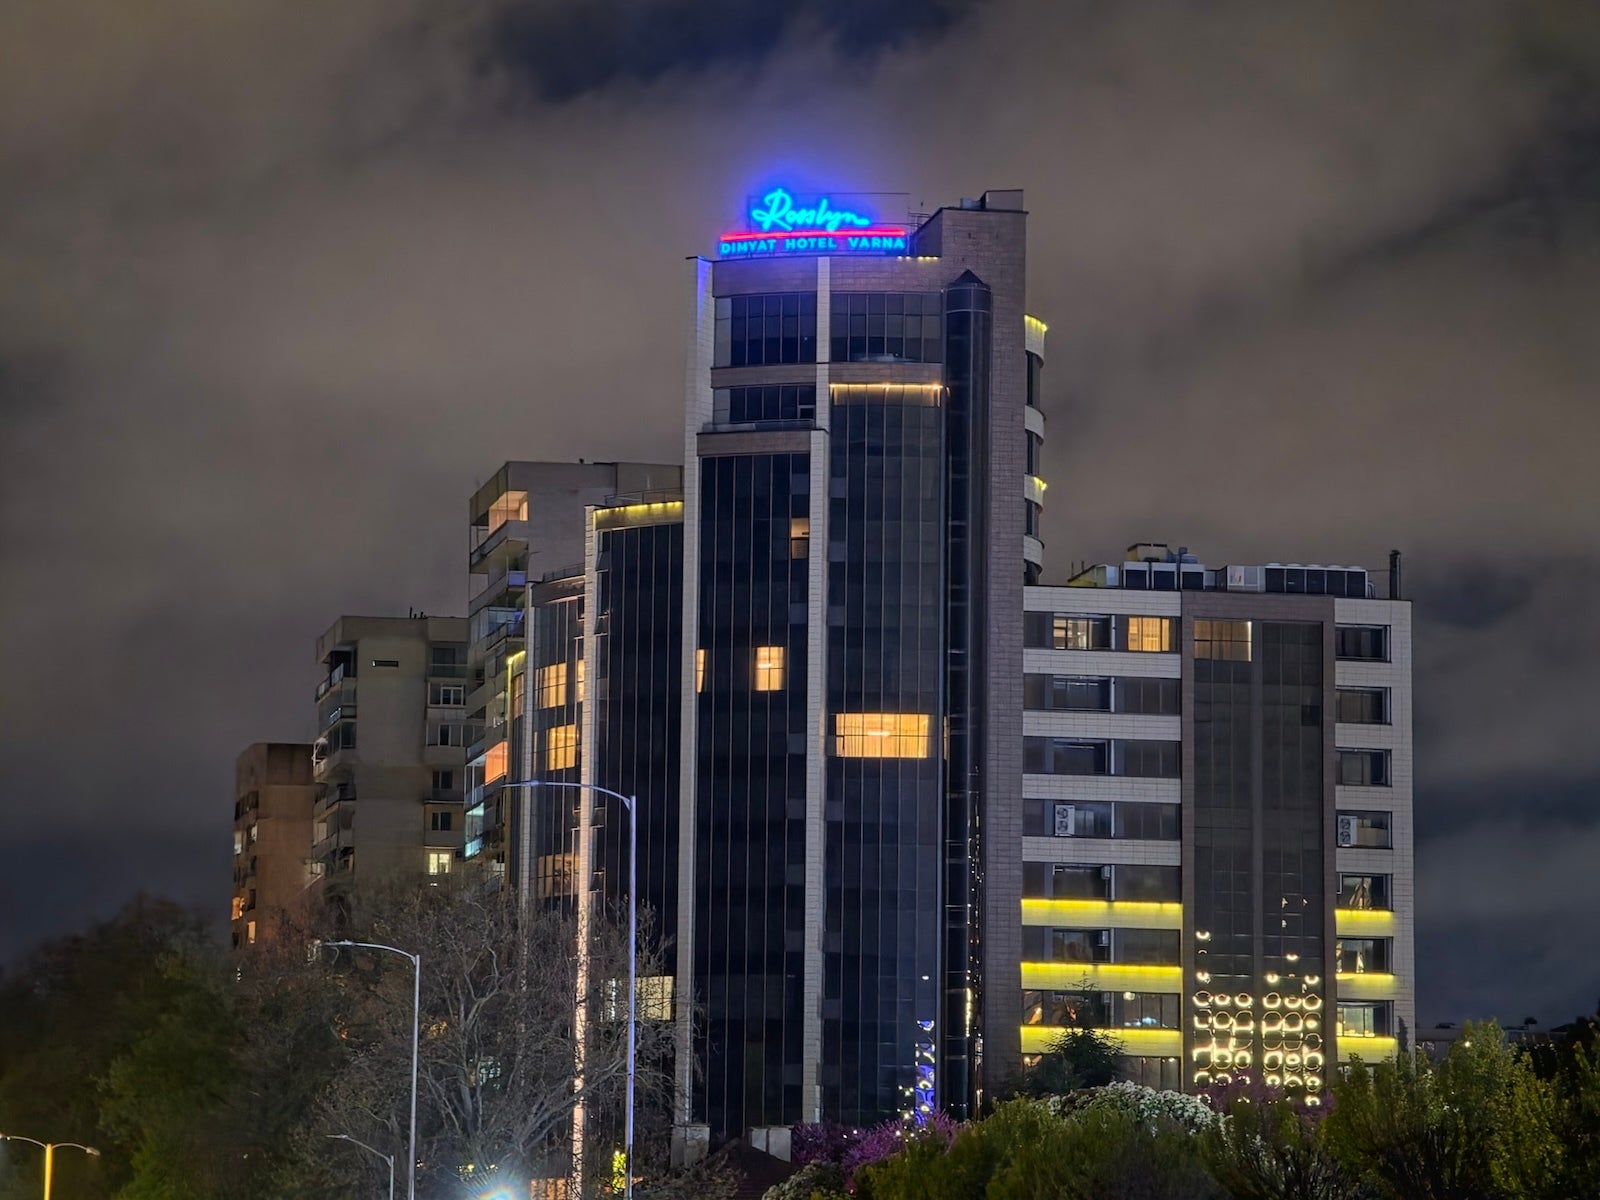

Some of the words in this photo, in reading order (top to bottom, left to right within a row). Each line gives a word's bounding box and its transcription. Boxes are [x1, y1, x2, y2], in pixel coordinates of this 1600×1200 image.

[752, 188, 870, 231] Rosslyn
[720, 239, 776, 254] DIMYAT
[785, 238, 837, 250] HOTEL
[848, 237, 905, 249] VARNA
